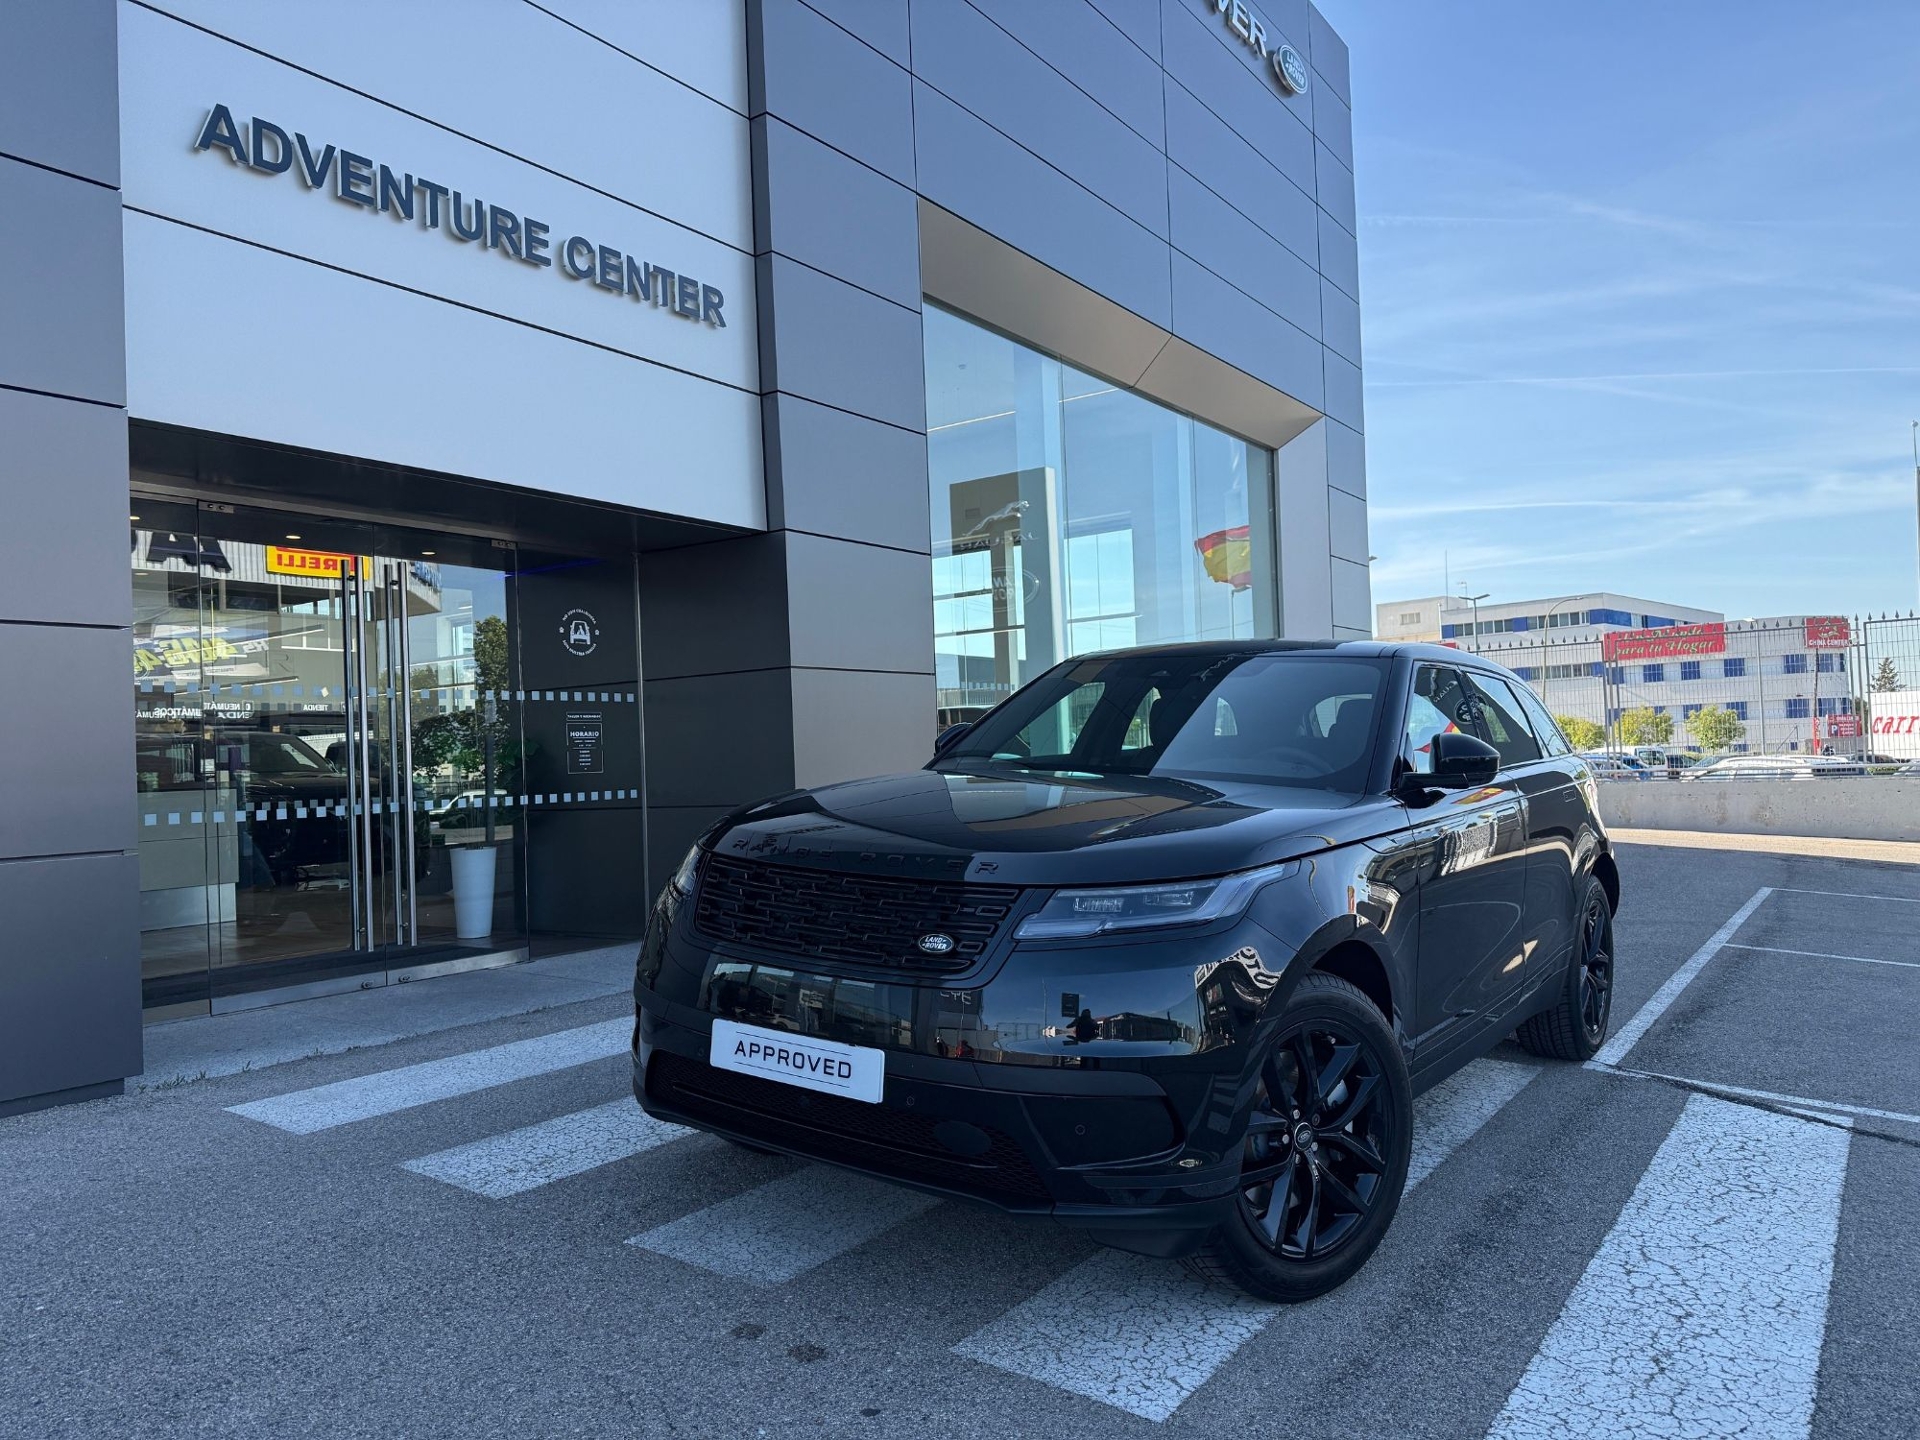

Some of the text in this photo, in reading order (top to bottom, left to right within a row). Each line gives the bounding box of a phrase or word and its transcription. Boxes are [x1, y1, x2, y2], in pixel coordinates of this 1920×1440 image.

[195, 102, 727, 328] ADVENTURE CENTER
[1665, 639, 1716, 654] Hogar
[860, 852, 999, 875] ROVER
[734, 1040, 852, 1079] APPROVED
